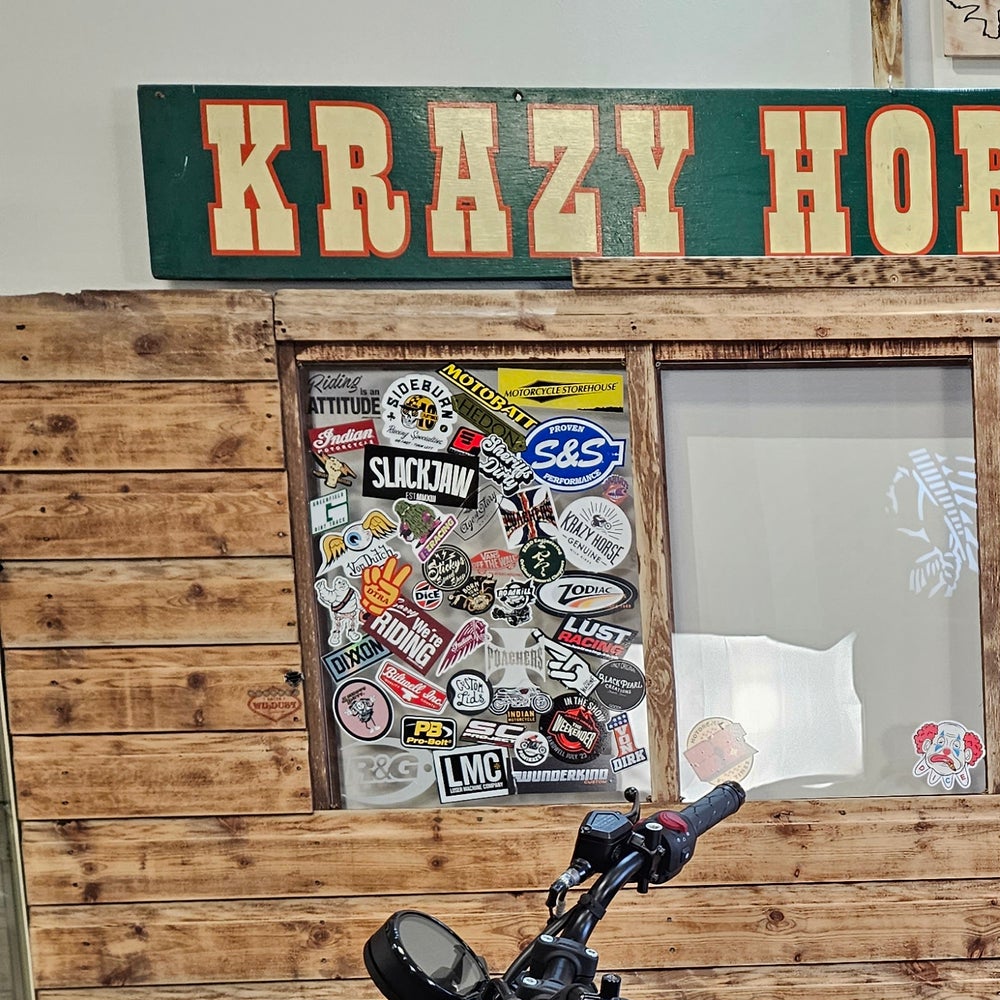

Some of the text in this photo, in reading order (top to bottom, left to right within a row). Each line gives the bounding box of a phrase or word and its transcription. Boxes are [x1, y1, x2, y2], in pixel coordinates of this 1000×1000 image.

[201, 99, 695, 258] KRAZY
[308, 373, 363, 393] Riding
[369, 388, 380, 396] an
[505, 382, 617, 398] MOTORCYCLE STOREHOUSE
[308, 396, 381, 415] ATTITUDE
[387, 379, 453, 419] SIDEBURN
[443, 363, 537, 429] MOTOBATT
[457, 401, 519, 448] HEDON
[549, 424, 586, 434] PROVEN
[313, 428, 375, 449] Indian
[531, 438, 605, 469] S&S
[369, 456, 475, 499] SLACKJAW
[479, 457, 518, 490] Dirty
[542, 470, 602, 486] PERFORMANCE
[561, 510, 595, 541] KRAZY
[591, 534, 624, 565] HORSE
[363, 546, 398, 567] Dutch
[481, 551, 500, 560] VANS
[568, 537, 602, 563] GENUINE
[484, 559, 499, 570] THE
[367, 588, 389, 604] DTRA
[557, 583, 613, 605] ZODIAC
[370, 611, 437, 668] RIDING
[563, 616, 632, 643] LUST
[558, 632, 626, 655] RACING
[331, 639, 385, 674] DIXXON
[507, 710, 535, 718] INDIAN
[564, 696, 573, 706] IN
[573, 696, 588, 707] THE
[587, 702, 607, 722] SHOW
[413, 720, 444, 738] PB
[465, 720, 526, 738] SC
[552, 714, 597, 749] WEEKENDER
[406, 736, 449, 749] Pro-Bolt
[356, 753, 418, 782] R&G
[443, 751, 501, 788] LMC
[612, 749, 647, 771] DIRK
[513, 768, 609, 783] WUNDERKIND
